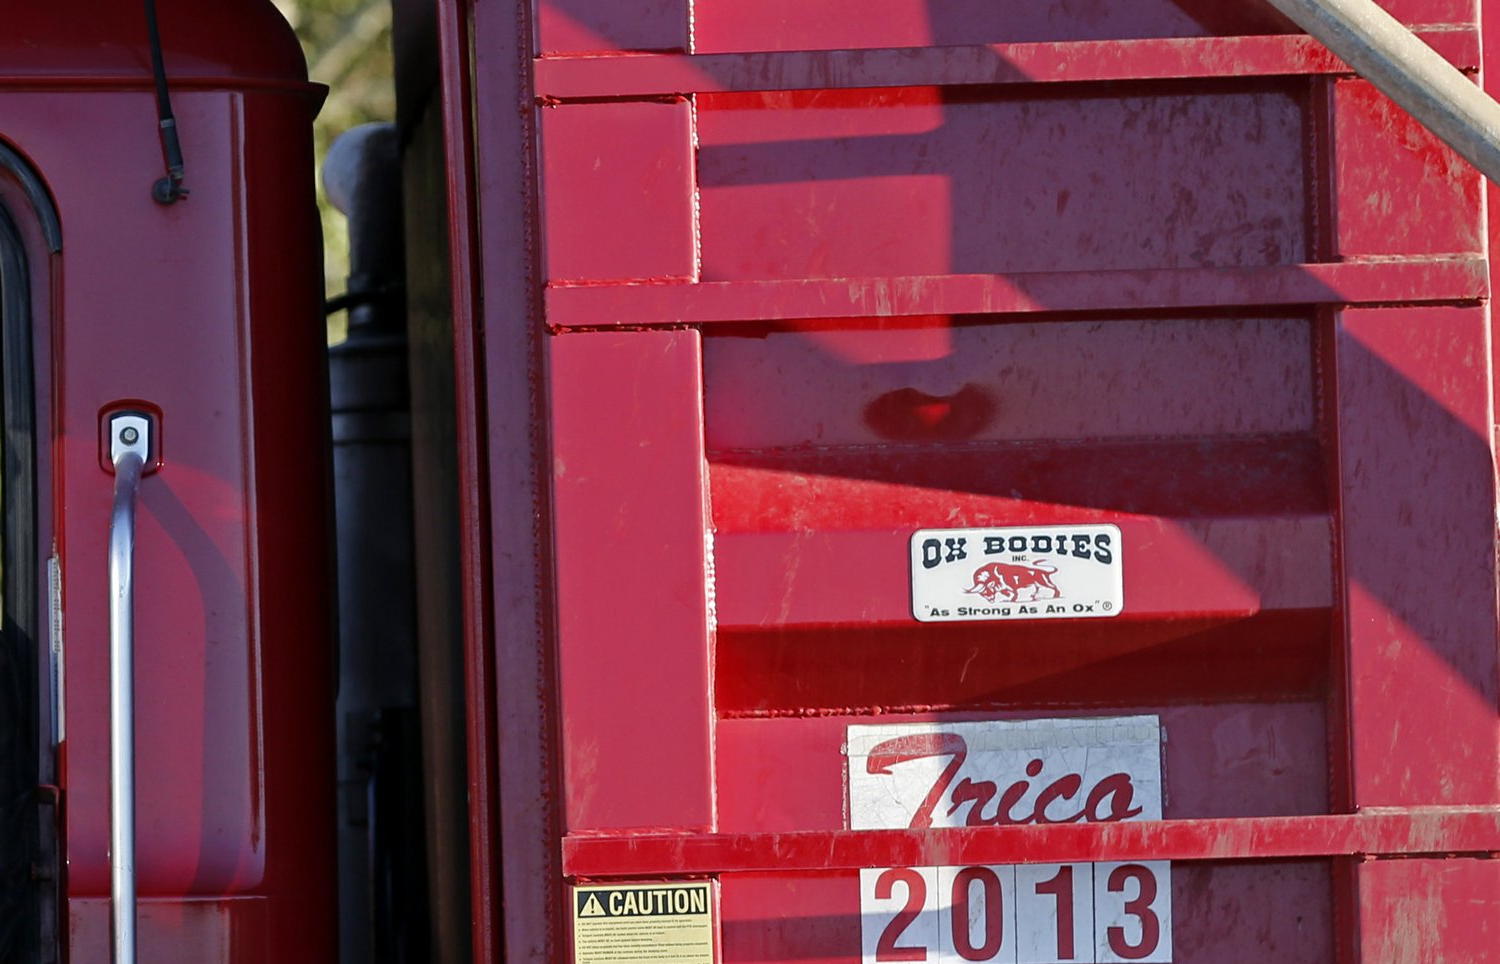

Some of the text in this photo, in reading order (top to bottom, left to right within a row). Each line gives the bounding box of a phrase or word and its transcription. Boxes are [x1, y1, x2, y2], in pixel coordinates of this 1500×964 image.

[922, 533, 1113, 569] OX BODIES
[1011, 554, 1030, 562] INC.
[957, 606, 1011, 617] Strong
[1015, 605, 1038, 615] As
[1045, 604, 1066, 614] An
[866, 732, 1144, 829] Trico
[609, 889, 705, 916] CAUTION
[874, 864, 1160, 962] 2013
